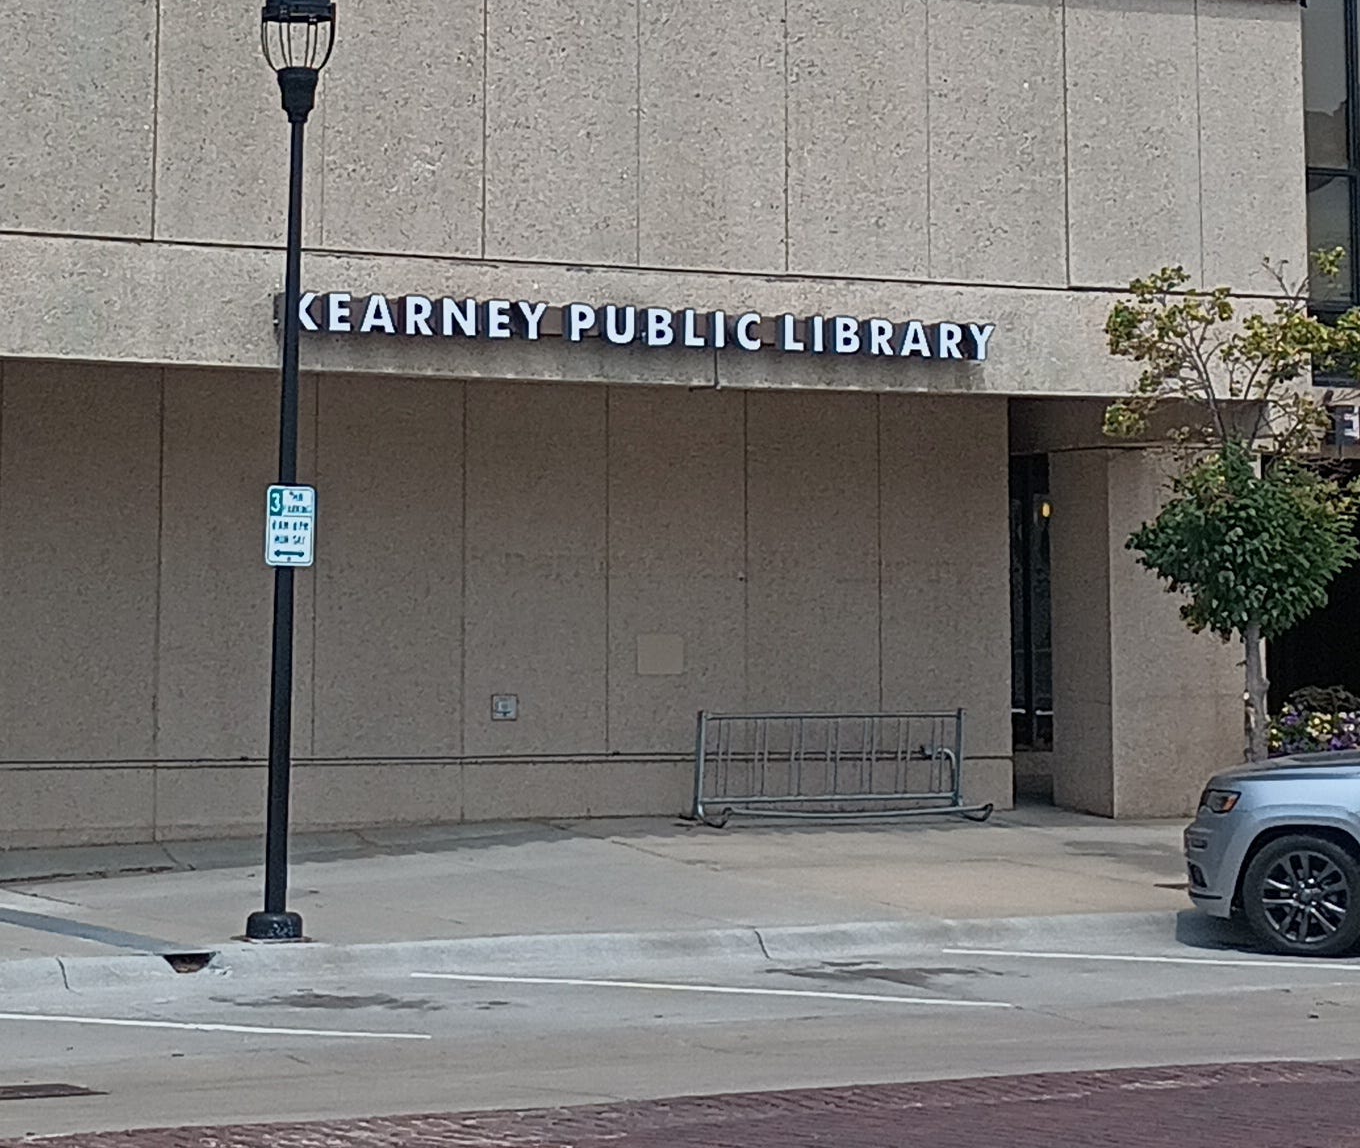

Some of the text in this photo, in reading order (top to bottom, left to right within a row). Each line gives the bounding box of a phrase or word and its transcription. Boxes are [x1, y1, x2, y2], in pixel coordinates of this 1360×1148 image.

[298, 292, 996, 361] KEARNEY PUBLIC LIBRARY
[270, 492, 281, 513] 3
